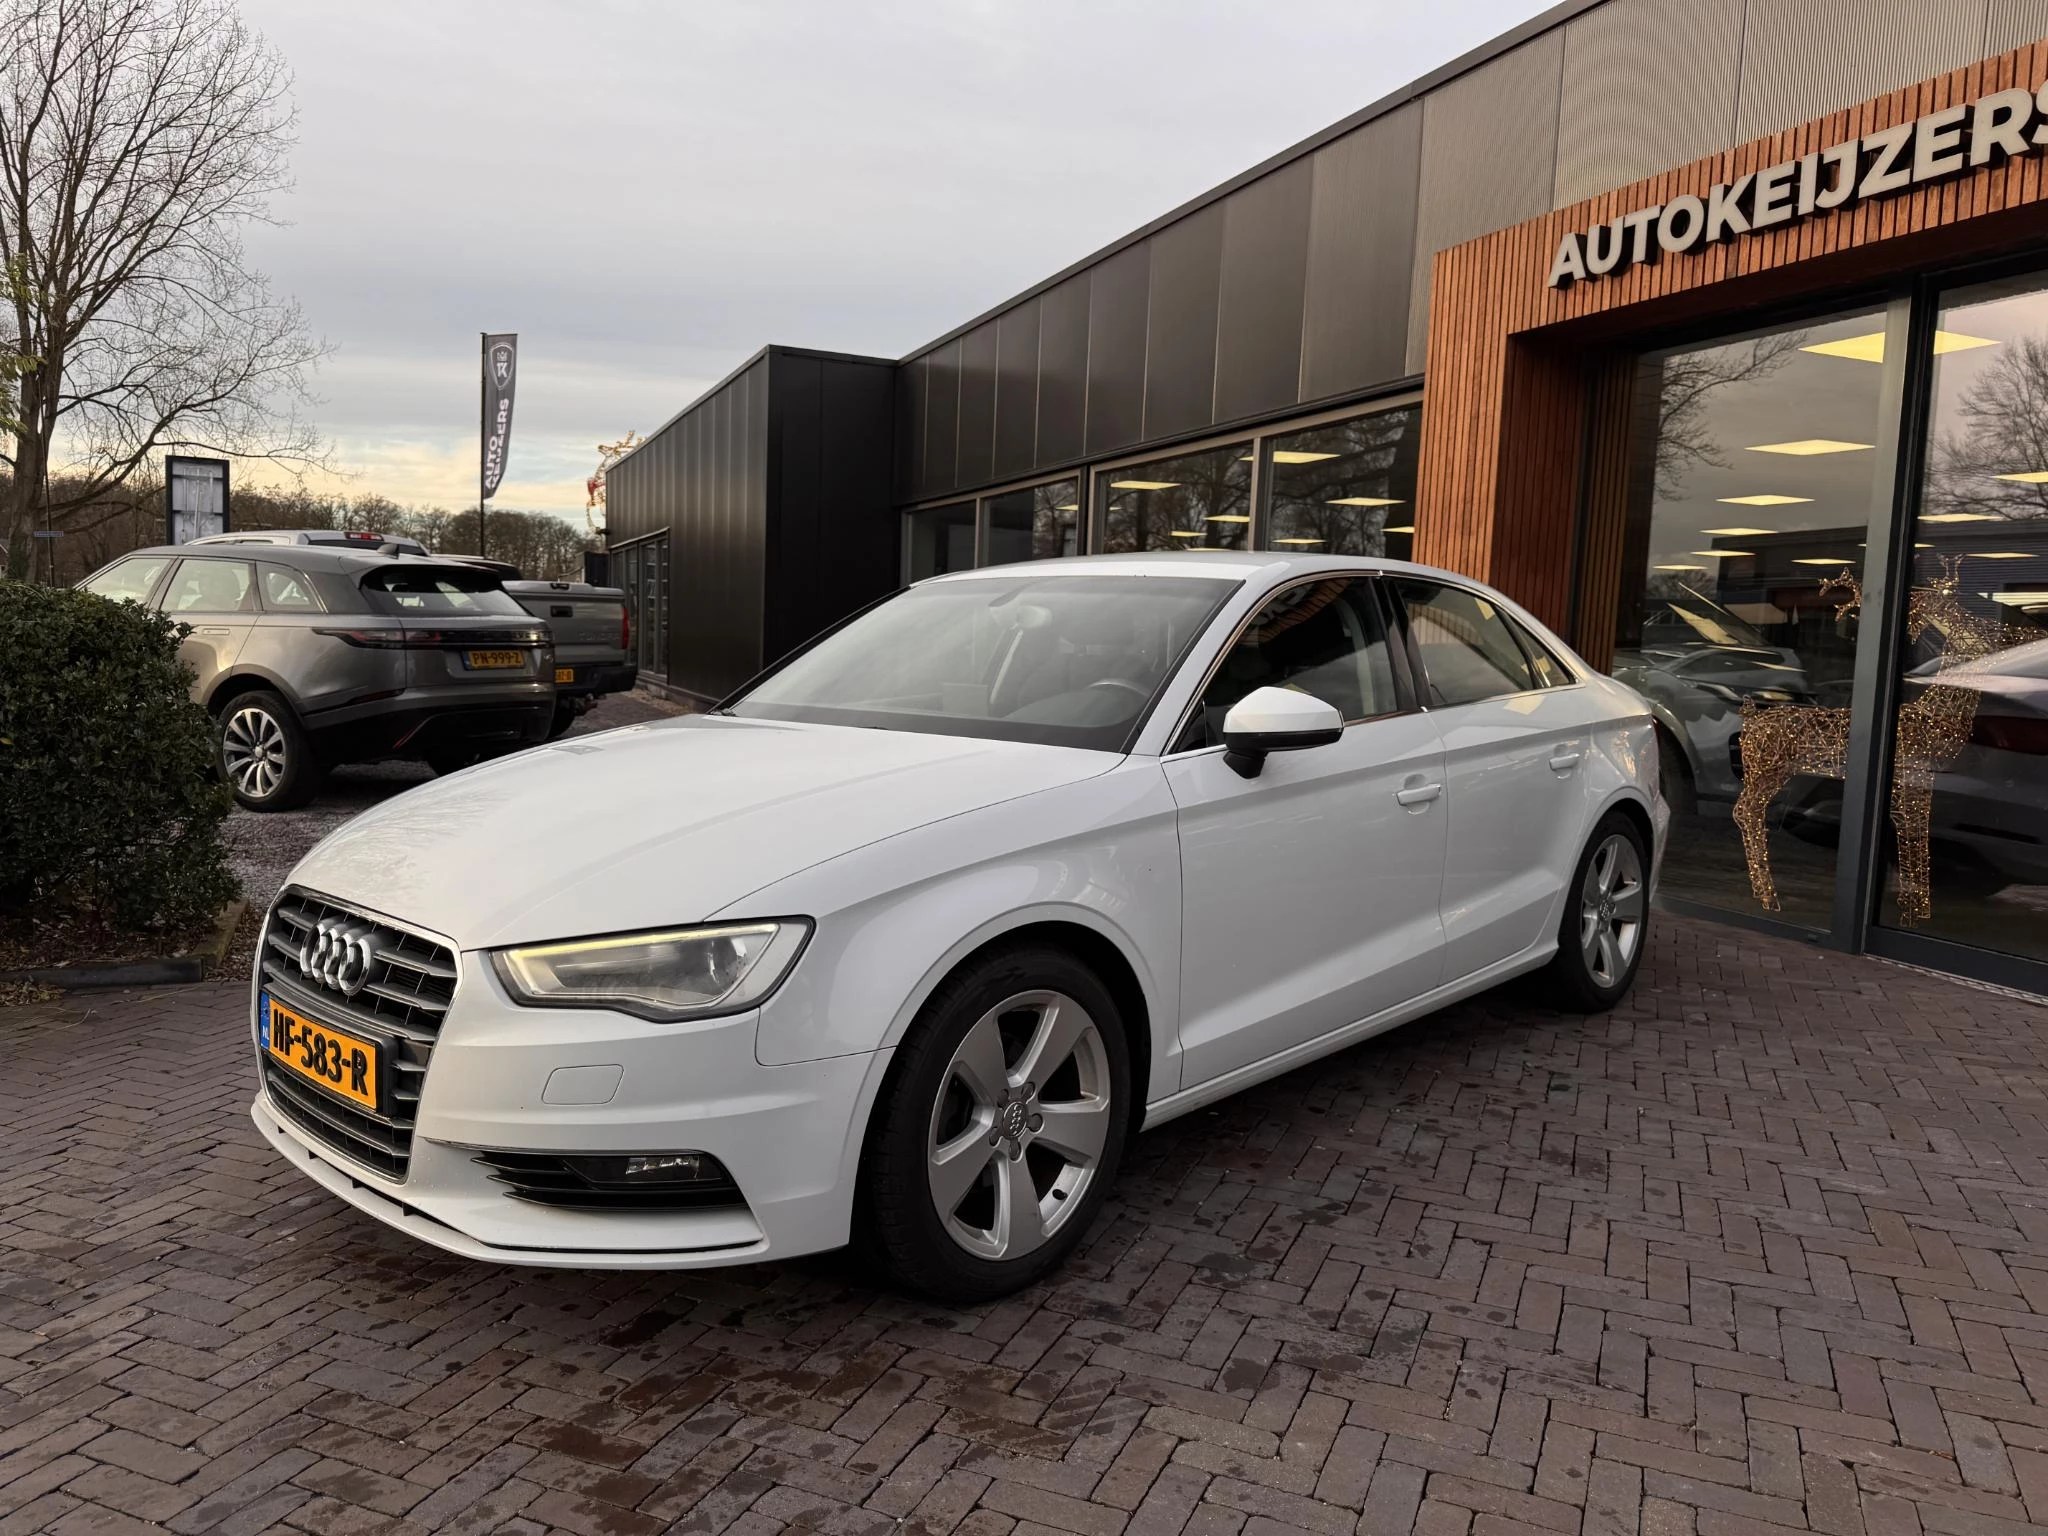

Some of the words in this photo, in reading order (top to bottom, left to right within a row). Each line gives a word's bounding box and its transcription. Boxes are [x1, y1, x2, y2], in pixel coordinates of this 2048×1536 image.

[485, 436, 498, 489] AUTO
[472, 652, 521, 665] PN-999-Z
[262, 1025, 270, 1040] NL
[273, 1008, 368, 1096] HF-583-R
